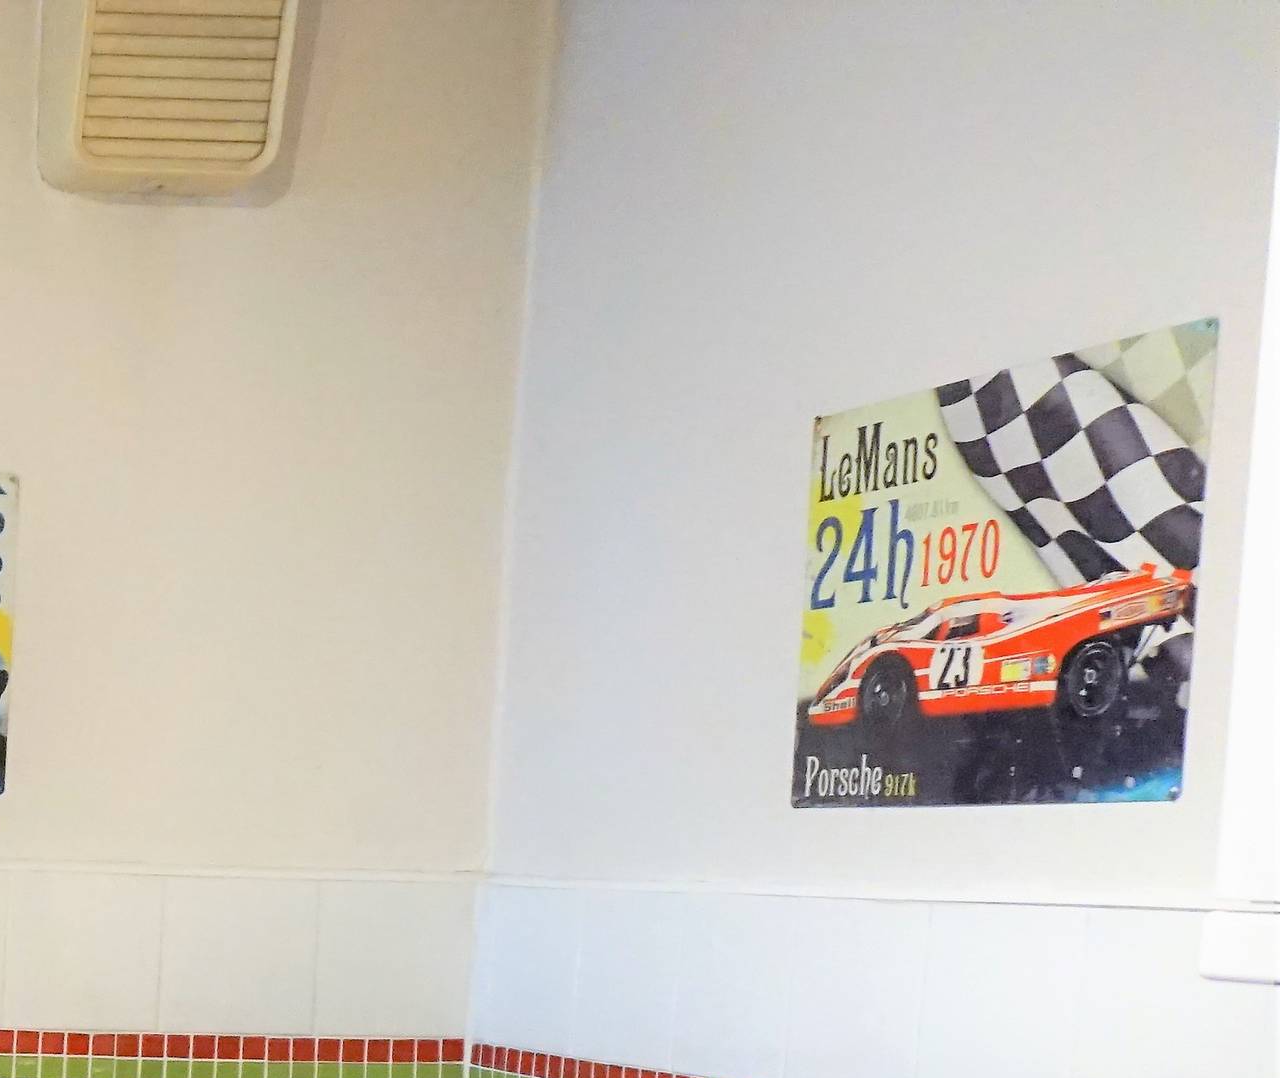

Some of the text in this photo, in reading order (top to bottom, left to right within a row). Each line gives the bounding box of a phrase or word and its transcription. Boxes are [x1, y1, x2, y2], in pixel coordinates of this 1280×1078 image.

[810, 498, 915, 610] 24h
[920, 519, 1000, 587] 1970
[937, 647, 971, 690] 23
[804, 753, 883, 800] Porsche
